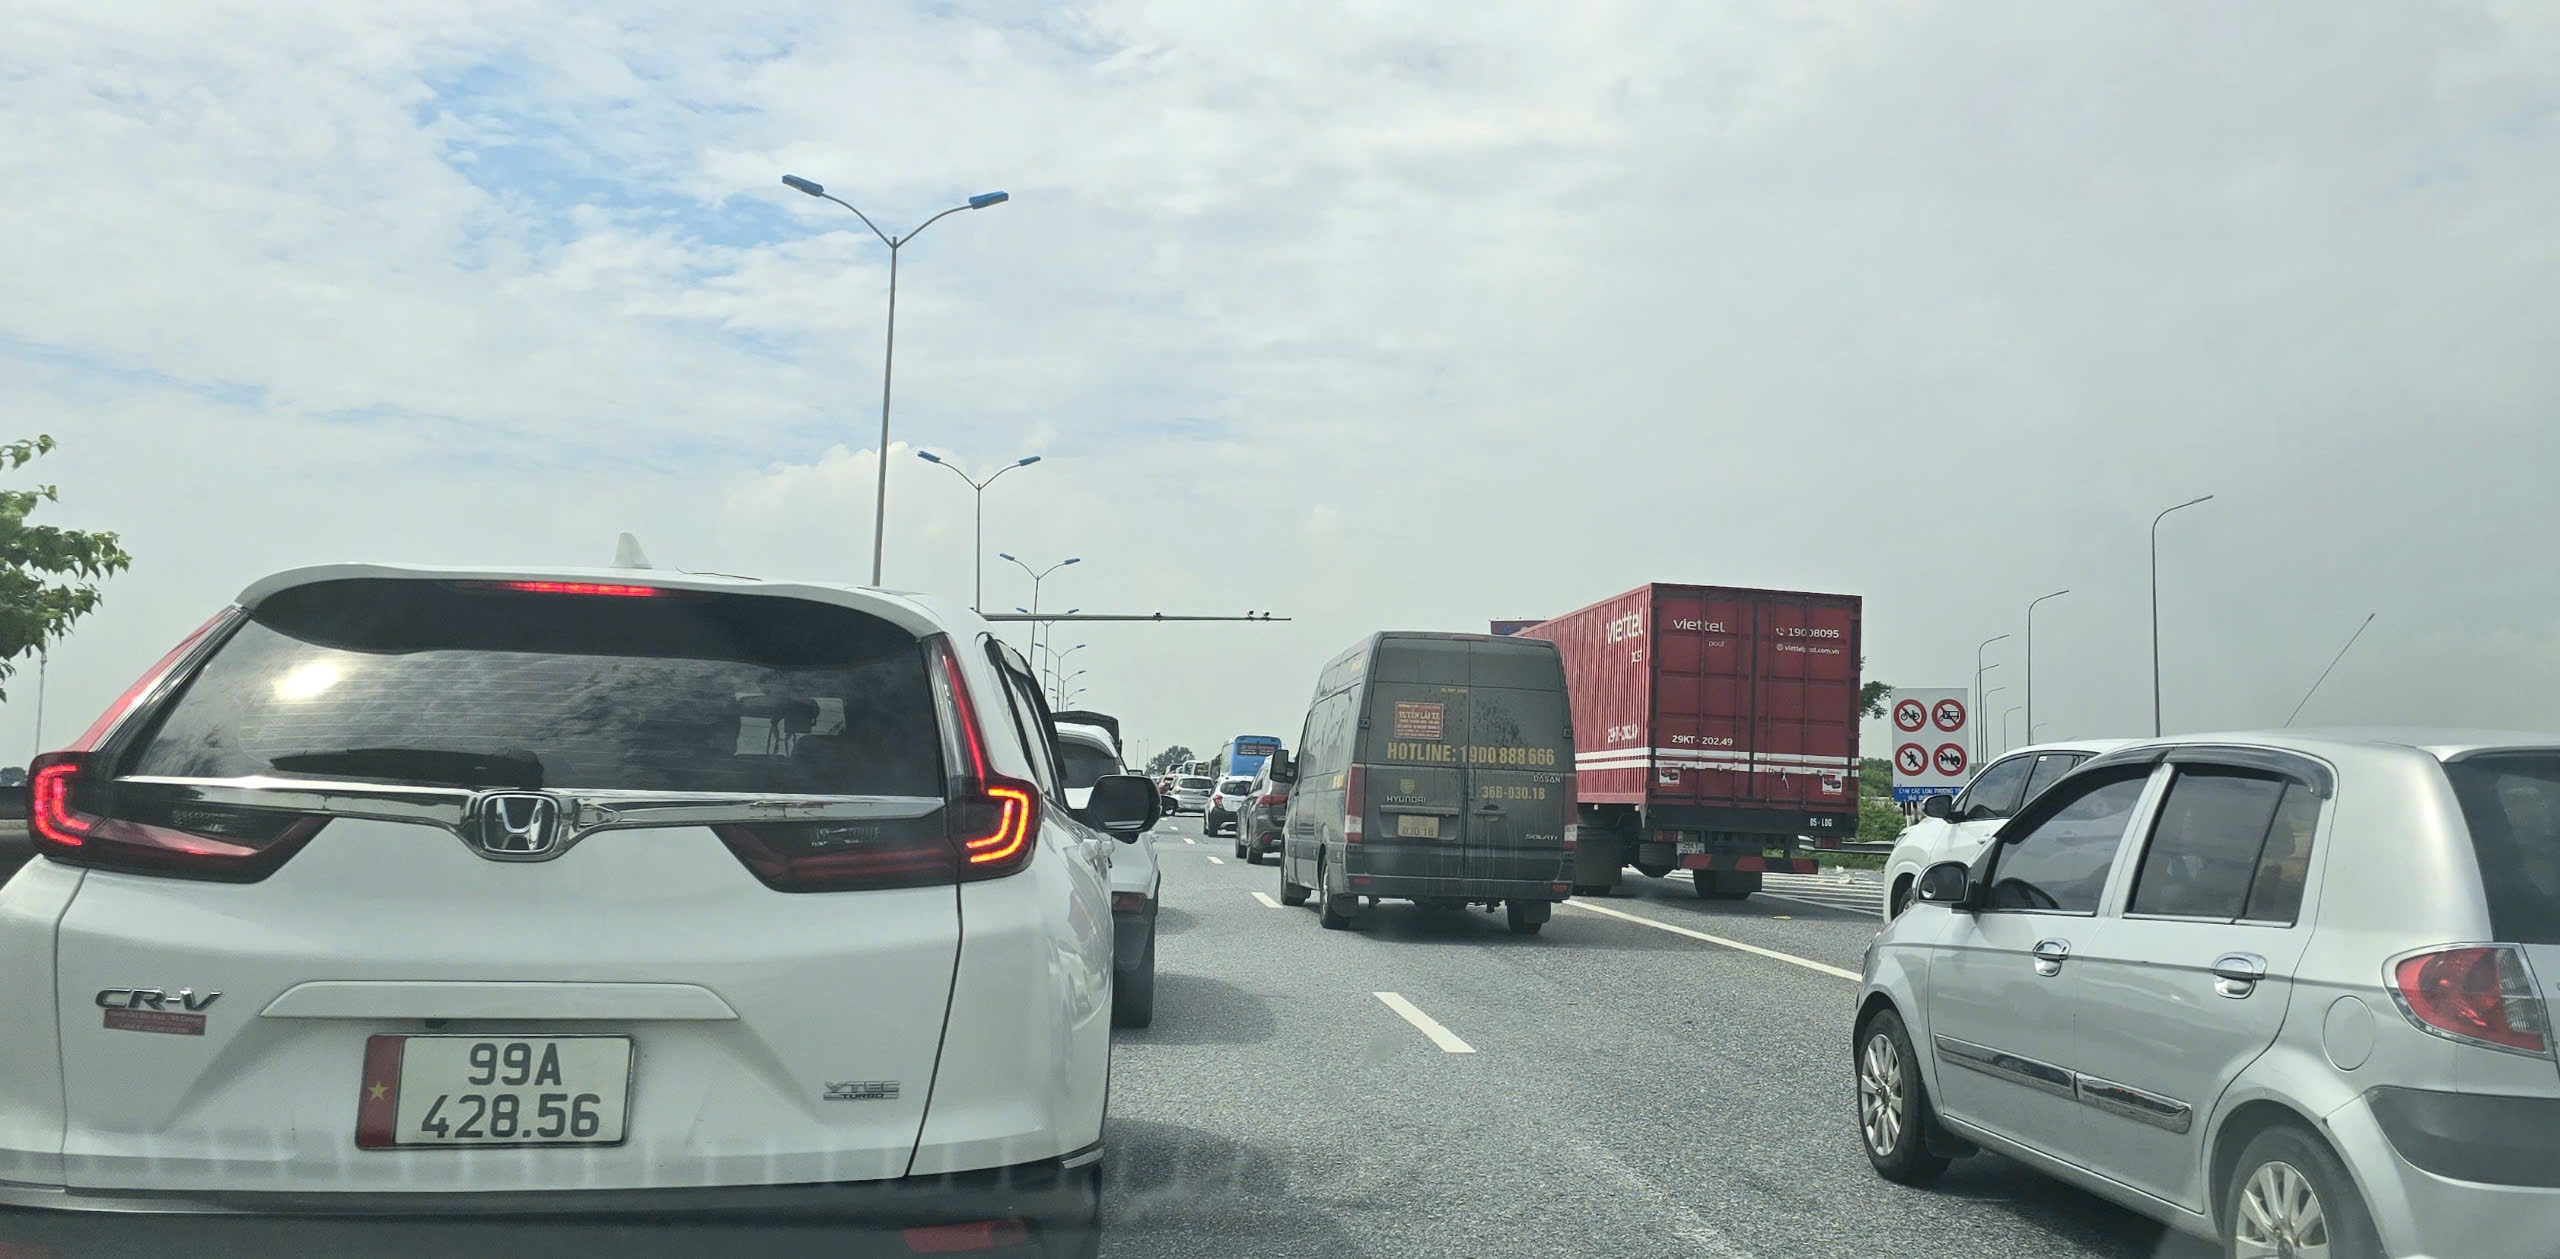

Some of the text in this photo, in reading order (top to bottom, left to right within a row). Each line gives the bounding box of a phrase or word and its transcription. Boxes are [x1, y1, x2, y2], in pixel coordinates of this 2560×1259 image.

[1673, 619, 1726, 633] viettel
[1387, 742, 1555, 766] HOTLINE: 1900 888 666
[1387, 795, 1427, 804] HYUNDAI
[1482, 786, 1545, 801] 36B-030.18
[95, 986, 223, 1011] CR-V
[468, 1042, 562, 1086] 99A
[824, 1080, 900, 1093] VTEC
[421, 1093, 601, 1138] 428.56
